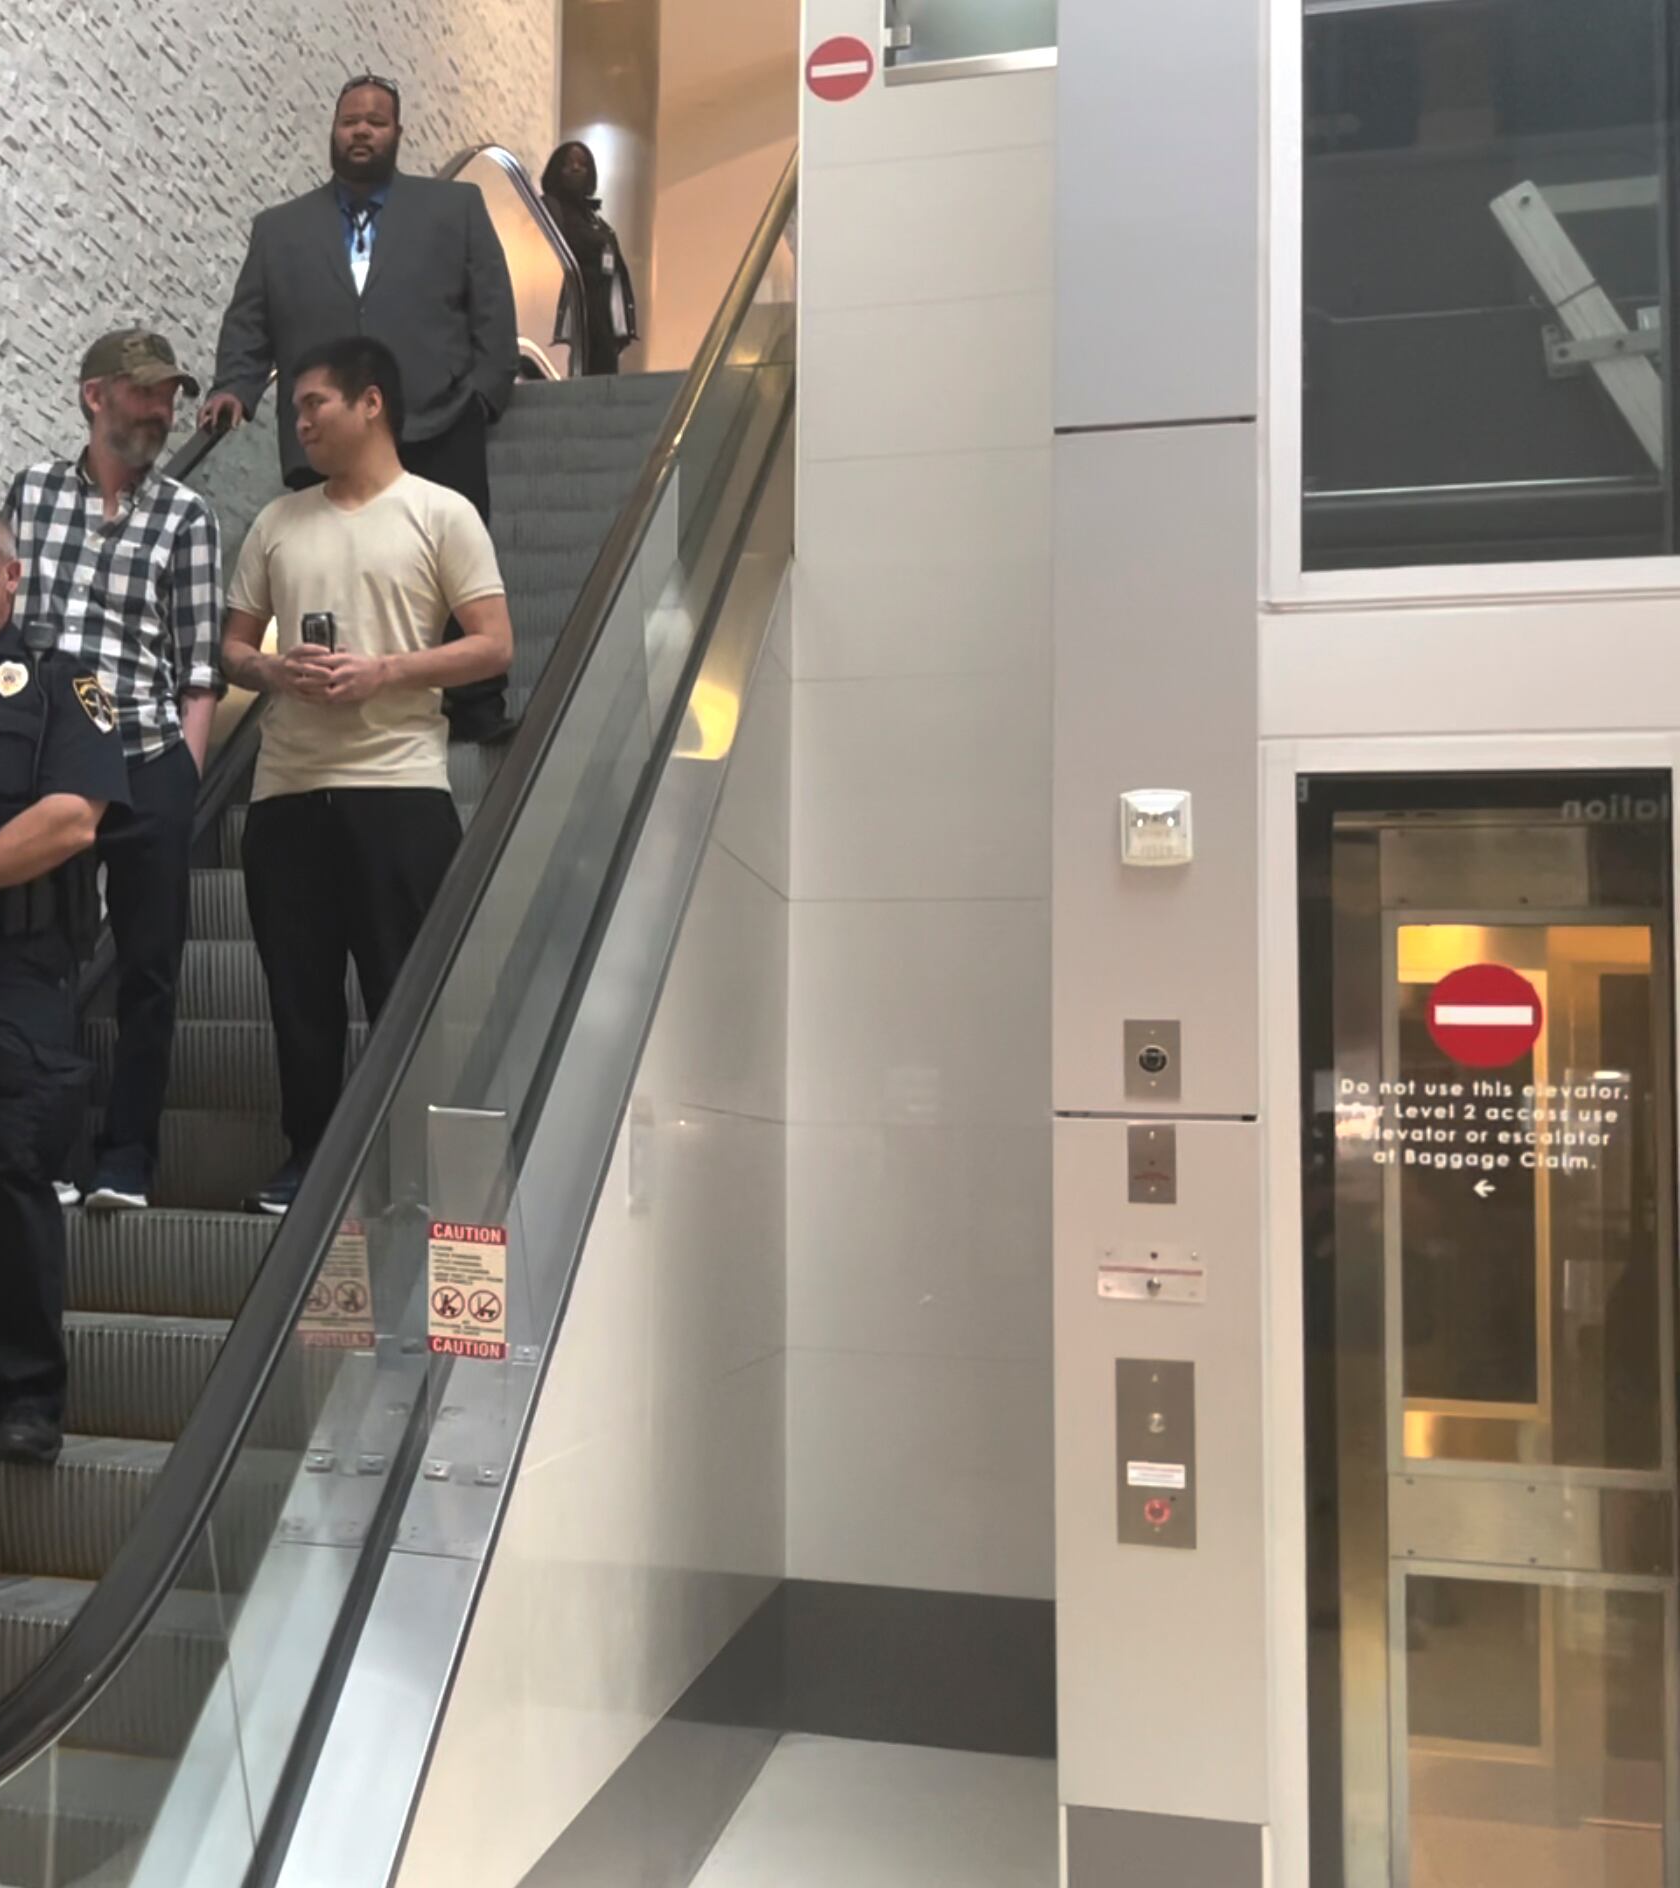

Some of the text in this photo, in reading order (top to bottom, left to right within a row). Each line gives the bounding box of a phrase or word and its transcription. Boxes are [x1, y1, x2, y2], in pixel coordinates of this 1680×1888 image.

[1340, 1078, 1629, 1100] Do not use this elevator.
[1393, 1103, 1455, 1120] Level
[1463, 1103, 1477, 1121] 2
[1485, 1106, 1569, 1122] access
[1578, 1108, 1619, 1124] use
[1465, 1128, 1488, 1144] or
[1497, 1127, 1611, 1146] escalator
[1372, 1148, 1598, 1170] at Baggage Claim.
[432, 1222, 502, 1243] CAUTION
[431, 1336, 500, 1358] CAUTION
